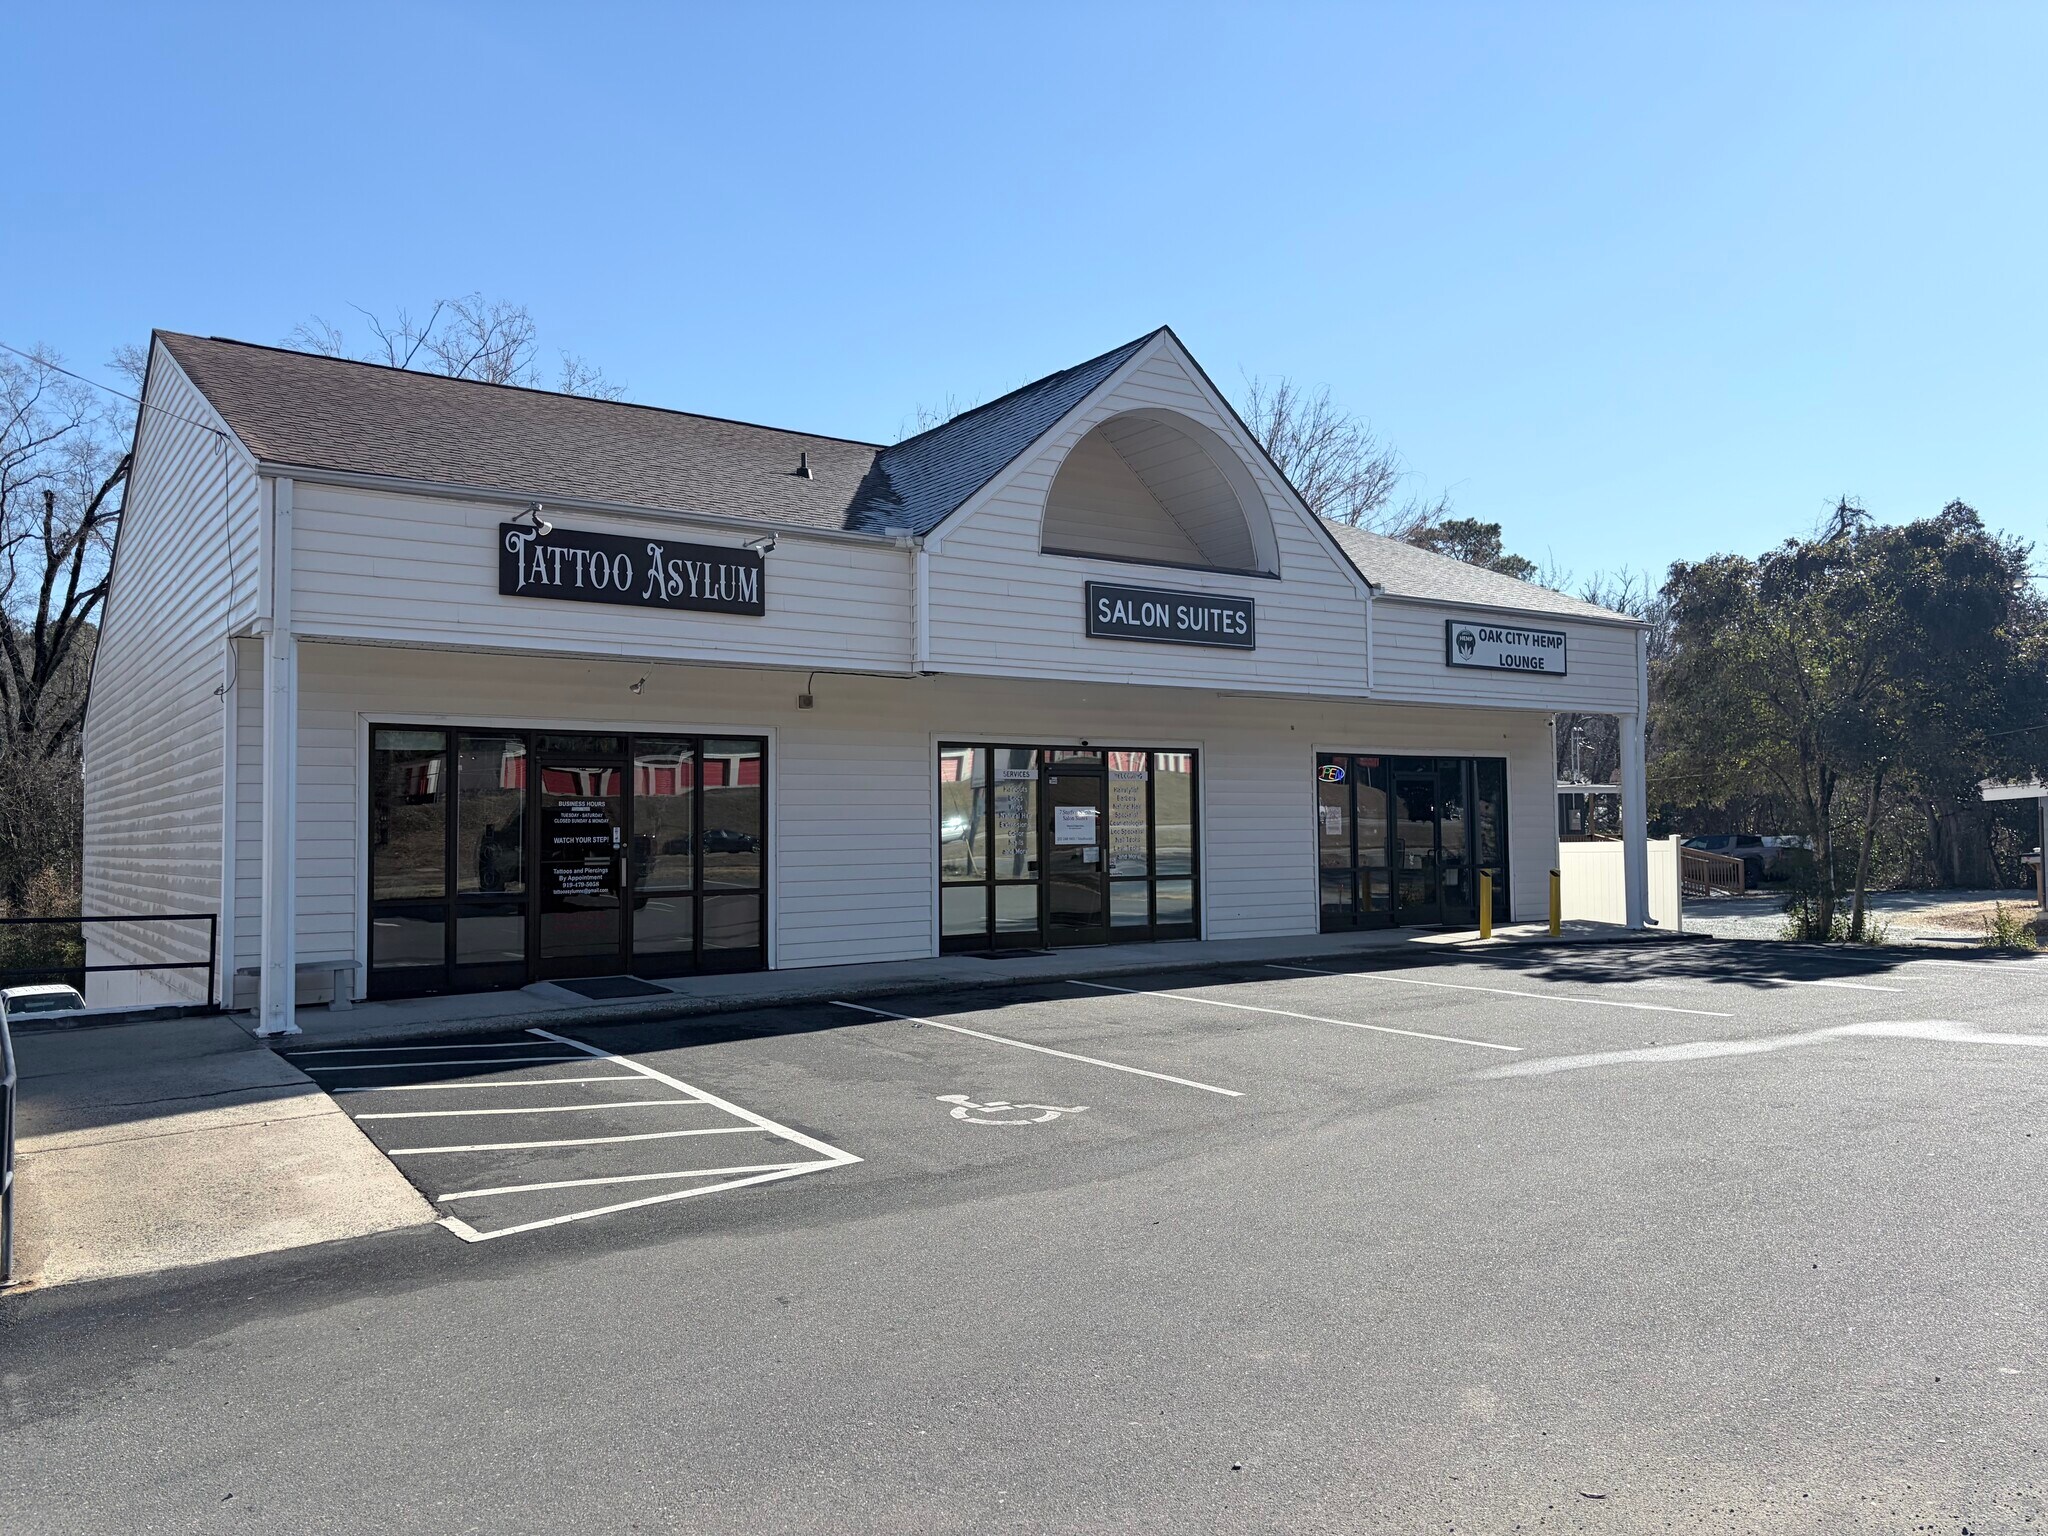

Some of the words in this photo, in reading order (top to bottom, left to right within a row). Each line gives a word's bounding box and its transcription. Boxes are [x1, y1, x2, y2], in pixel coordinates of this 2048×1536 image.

[505, 528, 633, 592] TATTOO
[642, 542, 759, 604] ASYLUM
[1098, 597, 1170, 628] SALON
[1176, 605, 1248, 635] SUITES
[1478, 628, 1503, 643] OAK
[1505, 631, 1530, 646] CITY
[1532, 634, 1563, 649] HEMP
[1499, 653, 1545, 670] LOUNGE
[1002, 770, 1031, 778] SERVICES
[575, 836, 592, 844] YOUR
[584, 867, 609, 875] Piercings
[567, 874, 603, 882] Appointment
